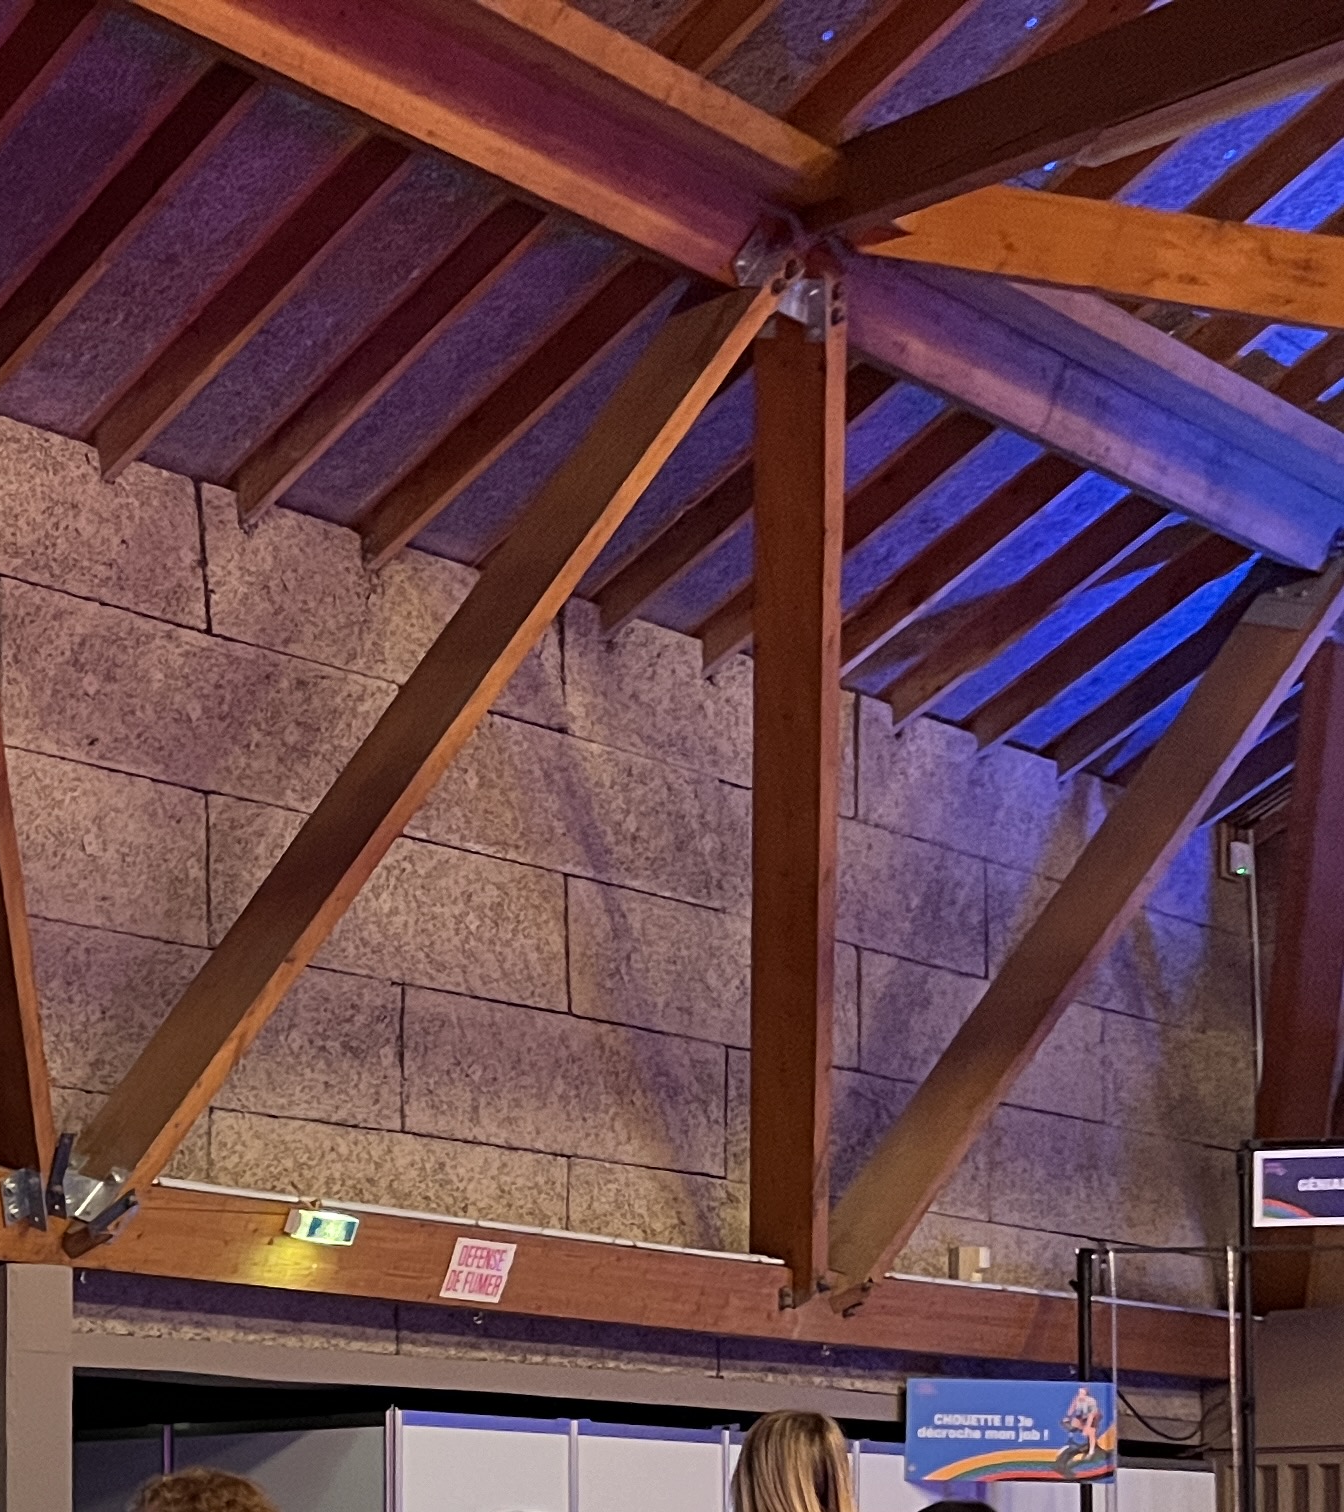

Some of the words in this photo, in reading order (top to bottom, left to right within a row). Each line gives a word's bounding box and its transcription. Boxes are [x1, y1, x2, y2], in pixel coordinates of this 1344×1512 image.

[458, 1245, 507, 1271] DEFENSE
[445, 1270, 463, 1291] DE
[462, 1272, 503, 1297] FUMER
[934, 1413, 1002, 1427] CHOUETTE
[985, 1429, 1015, 1440] mon
[1018, 1428, 1040, 1442] job
